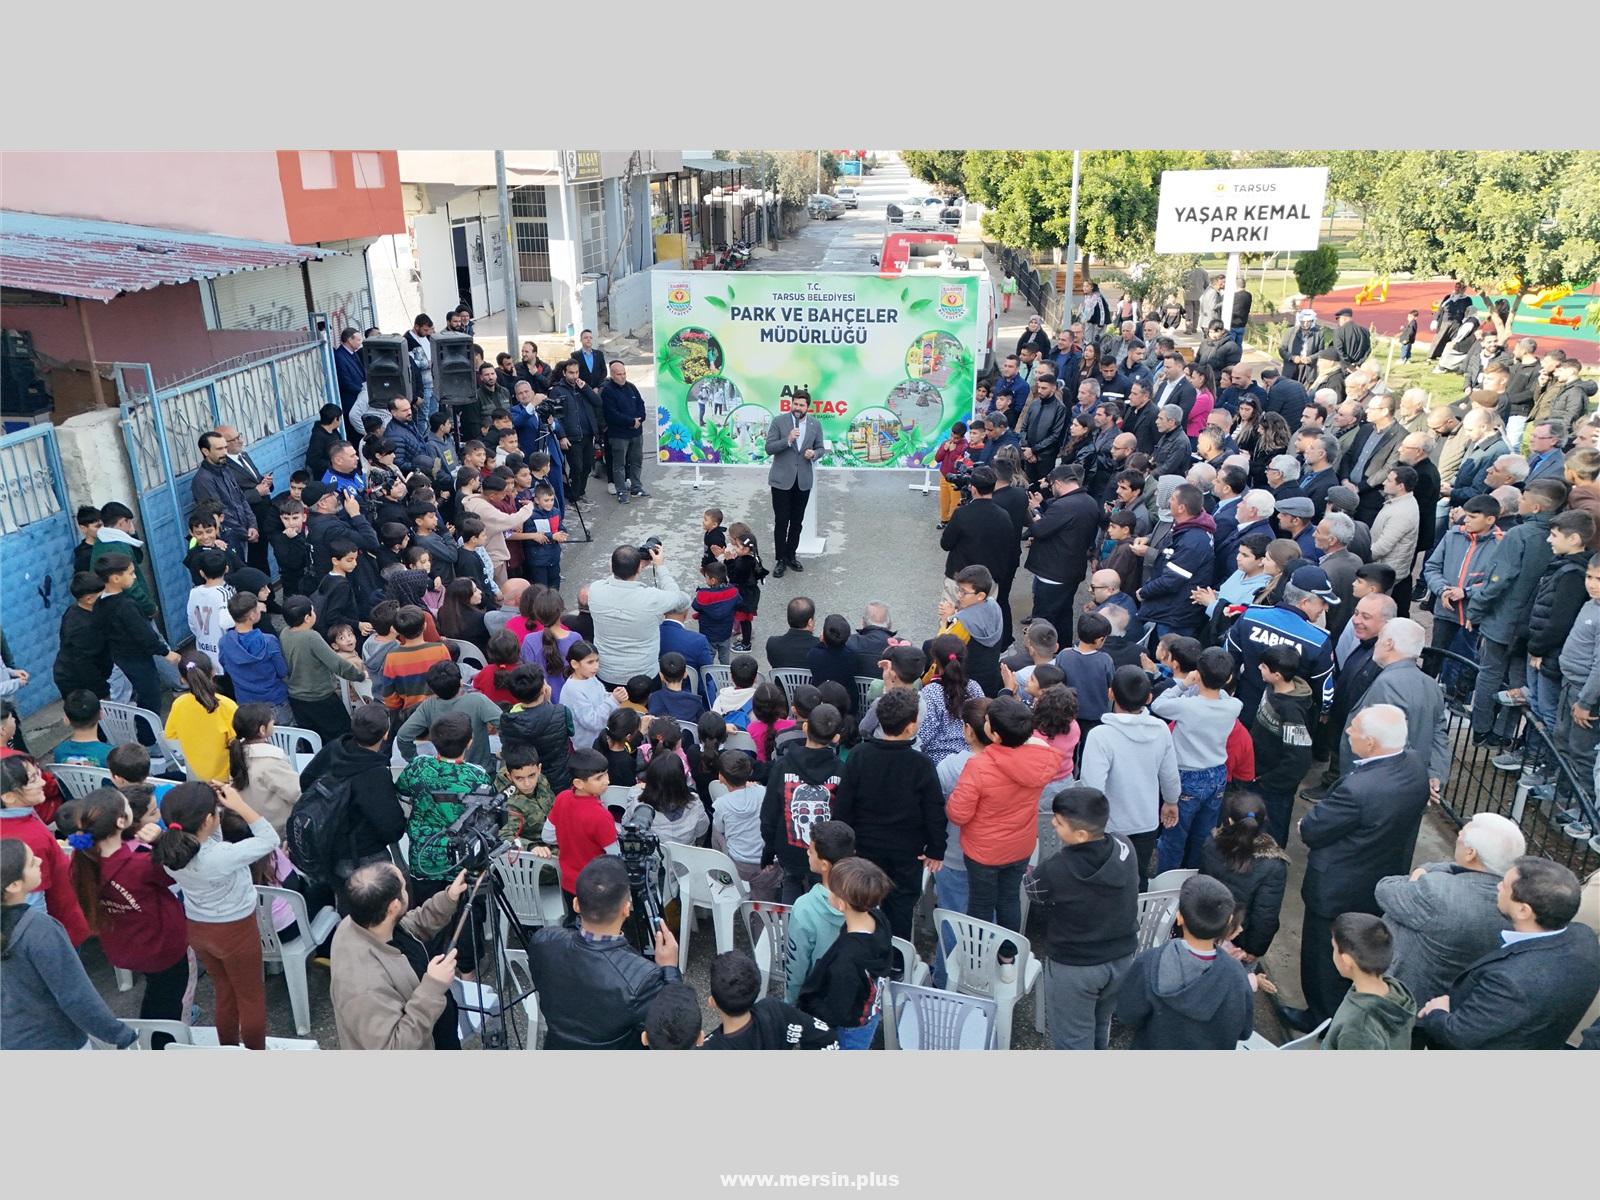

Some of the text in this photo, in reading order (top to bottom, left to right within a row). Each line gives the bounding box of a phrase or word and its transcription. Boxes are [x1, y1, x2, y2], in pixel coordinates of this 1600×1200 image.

[1233, 184, 1277, 192] TARSUS
[1175, 204, 1311, 224] YAŞAR KEMAL
[1211, 226, 1269, 242] PARKI
[807, 283, 821, 291] T.C.
[773, 293, 856, 302] TARSUS BELEDİYESİ
[731, 307, 898, 325] PARK VE BAHÇELER
[760, 325, 868, 344] MÜDÜRLÜĞÜ
[780, 400, 848, 416] BTAÇ
